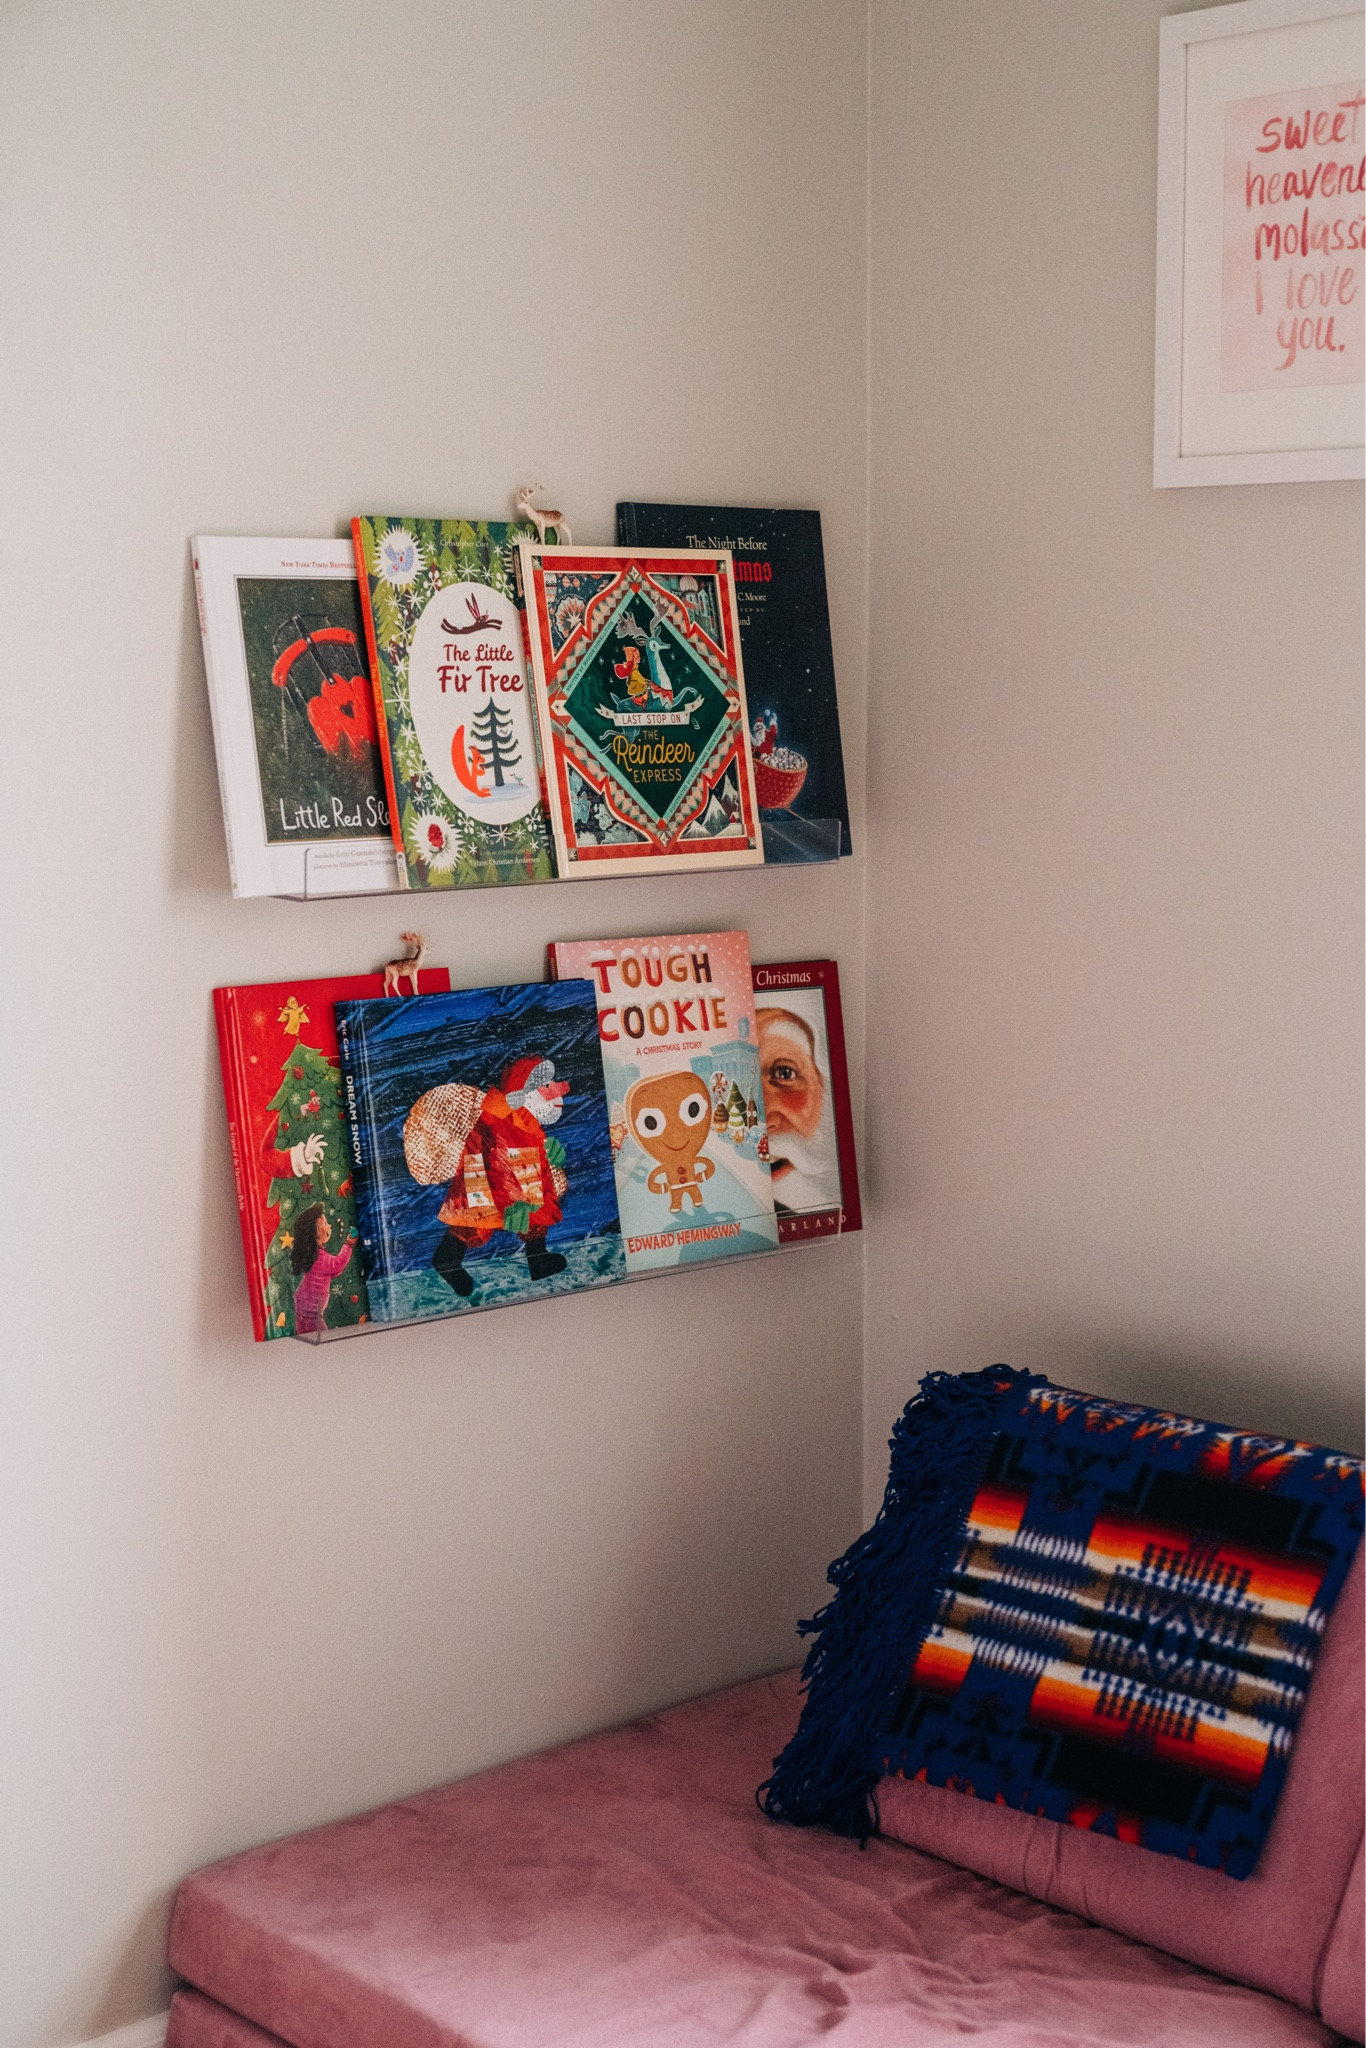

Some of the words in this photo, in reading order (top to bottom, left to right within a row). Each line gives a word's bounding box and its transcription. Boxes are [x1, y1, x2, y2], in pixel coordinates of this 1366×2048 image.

[1256, 89, 1365, 153] sweet
[1287, 266, 1357, 310] love
[1275, 316, 1345, 371] you.
[686, 535, 706, 549] The
[708, 536, 736, 550] Night
[737, 537, 767, 551] Before
[745, 593, 766, 601] Moore
[443, 644, 471, 661] The
[475, 643, 514, 661] Little
[437, 665, 472, 693] Fir
[475, 665, 524, 693] Tree
[622, 714, 642, 725] LAST
[646, 714, 667, 725] STOP
[670, 714, 681, 724] ON
[642, 729, 660, 740] THE
[613, 735, 695, 772] Reindeer
[633, 768, 682, 783] EXPRESS
[280, 798, 331, 830] Little
[332, 796, 362, 827] Red
[589, 947, 712, 993] TOUGH
[756, 970, 811, 986] Christmas
[597, 993, 727, 1042] COOKIE
[343, 1038, 351, 1060] Carle
[636, 1048, 642, 1056] A
[643, 1043, 681, 1055] CHRISTMAS
[682, 1041, 702, 1050] STORY
[345, 1075, 358, 1120] DREAM
[351, 1124, 362, 1165] SNOW
[627, 1233, 675, 1254] EDWARD
[676, 1222, 741, 1245] HEMINGWAY
